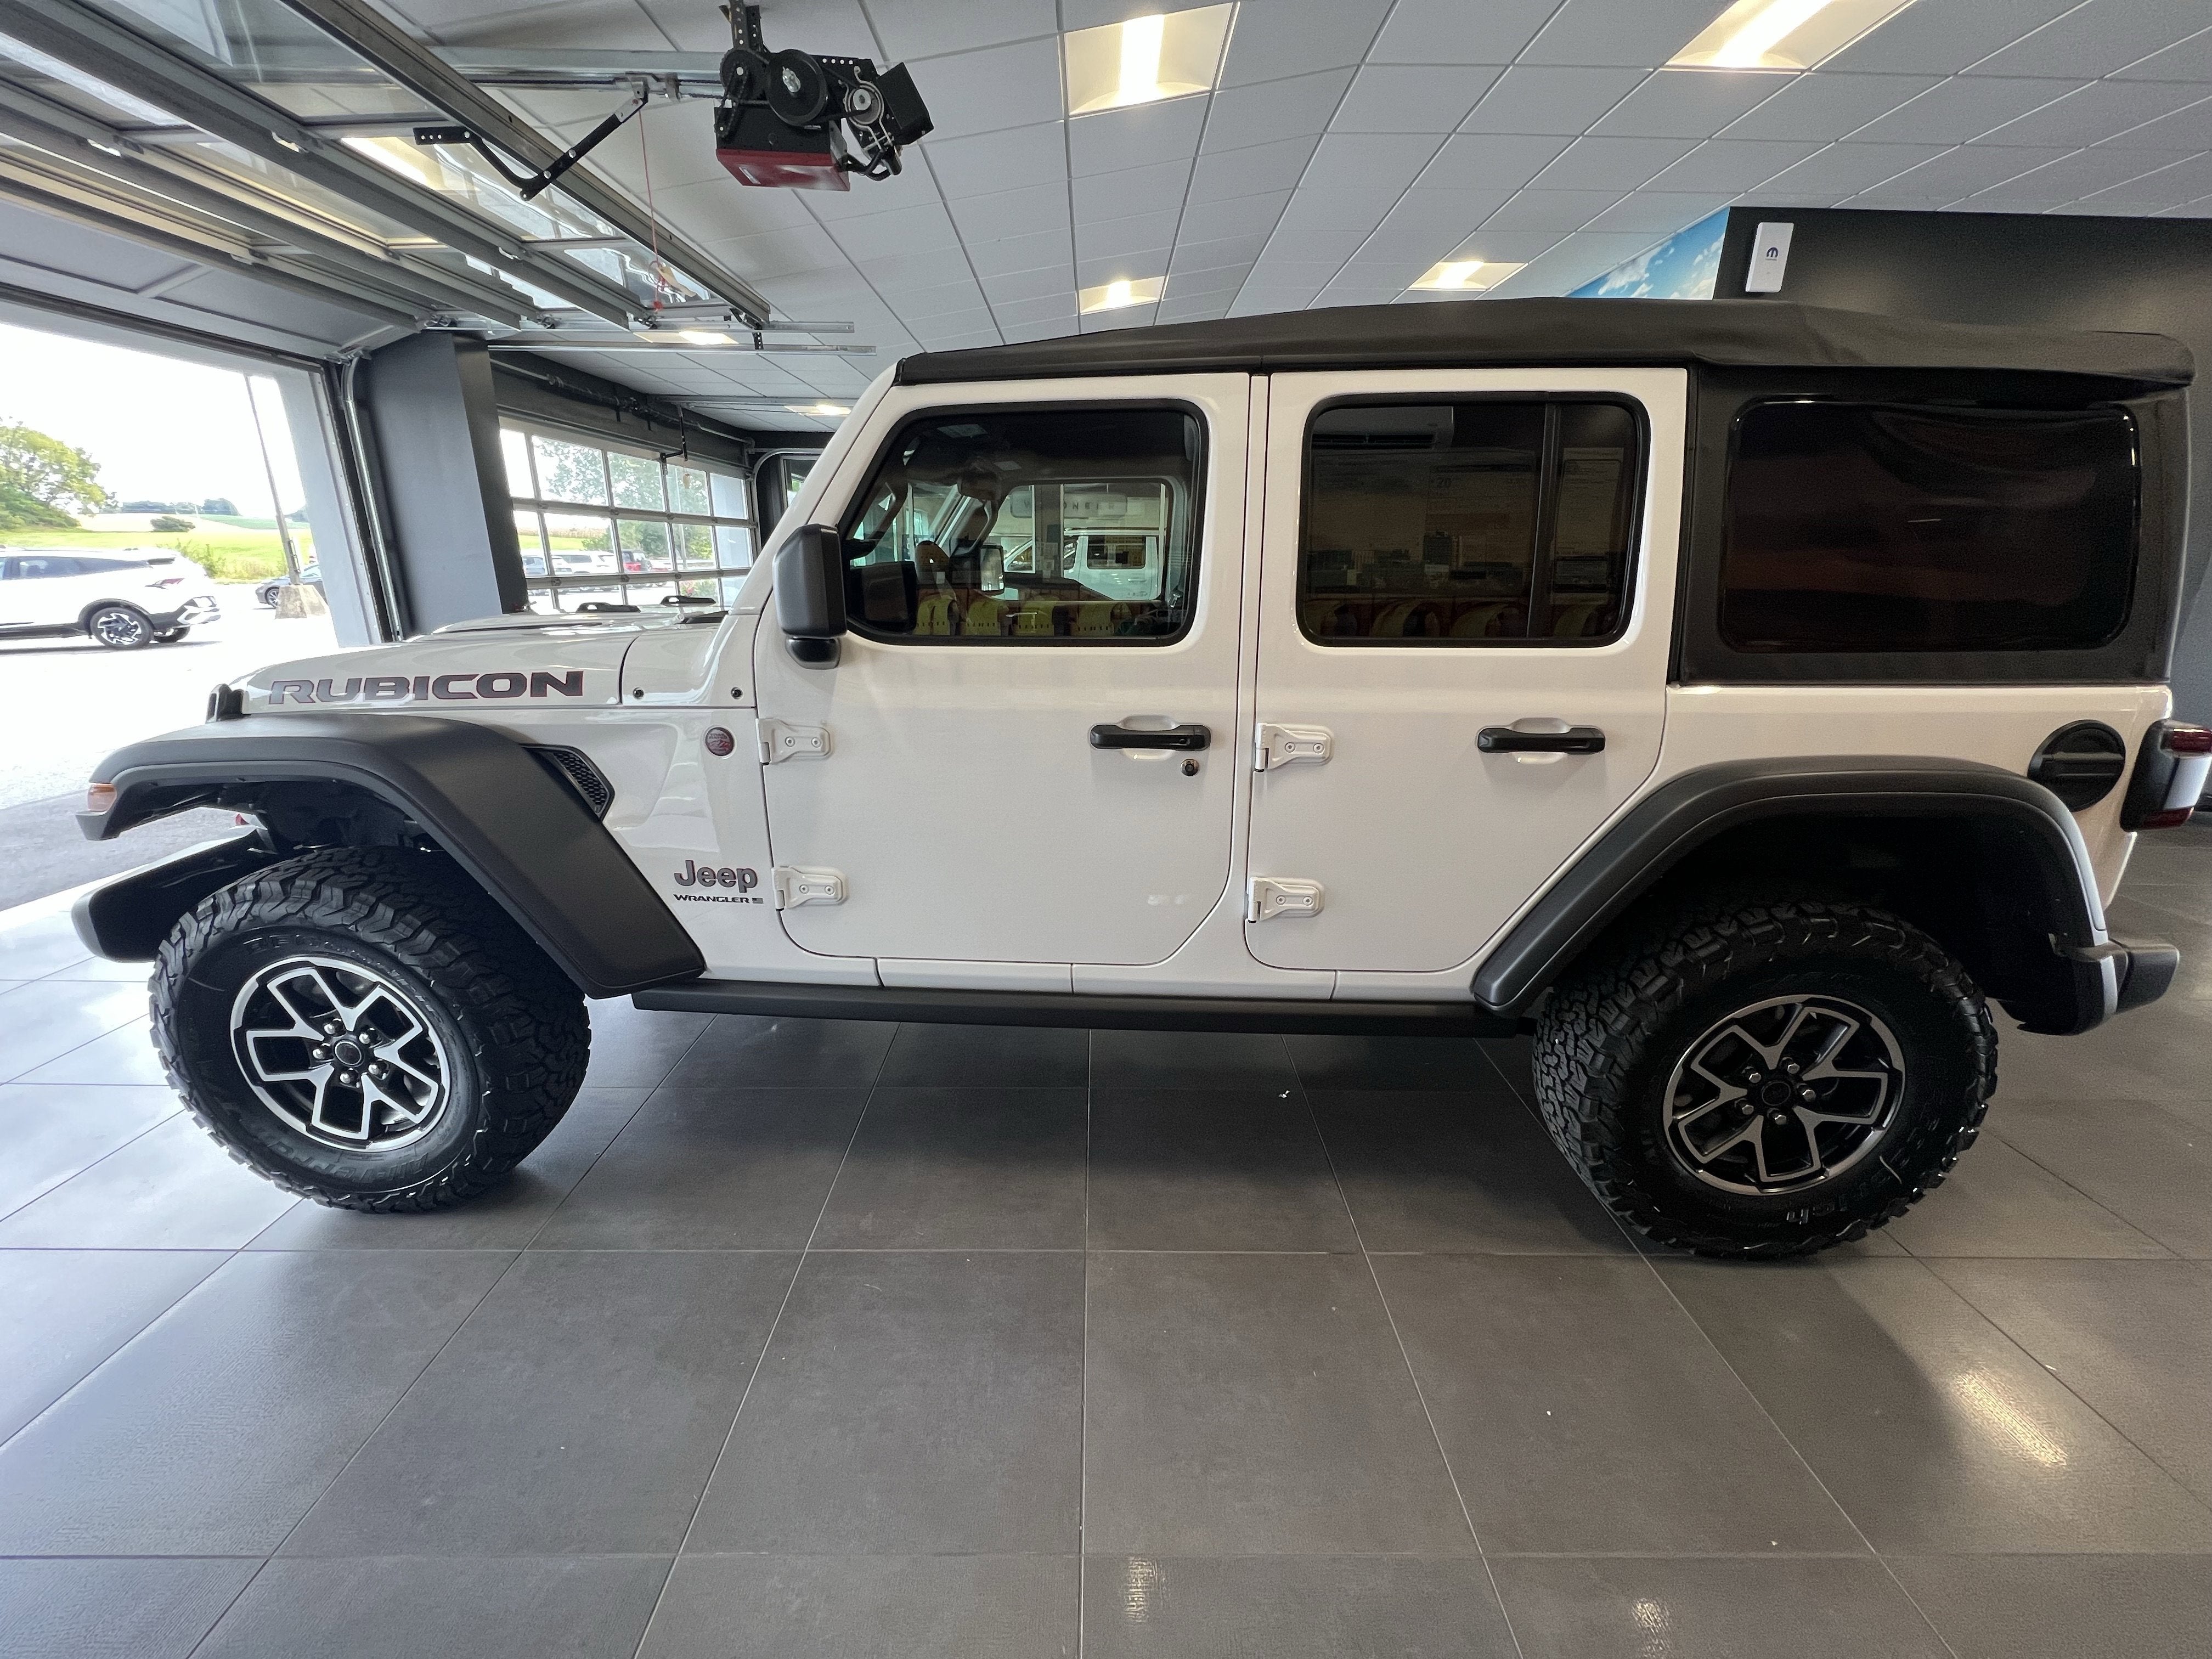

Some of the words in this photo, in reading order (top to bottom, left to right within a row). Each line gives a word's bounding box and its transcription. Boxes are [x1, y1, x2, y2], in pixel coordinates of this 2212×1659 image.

[268, 670, 584, 704] RUBICON
[674, 860, 758, 893] Jeep
[673, 894, 751, 904] WRANGLER
